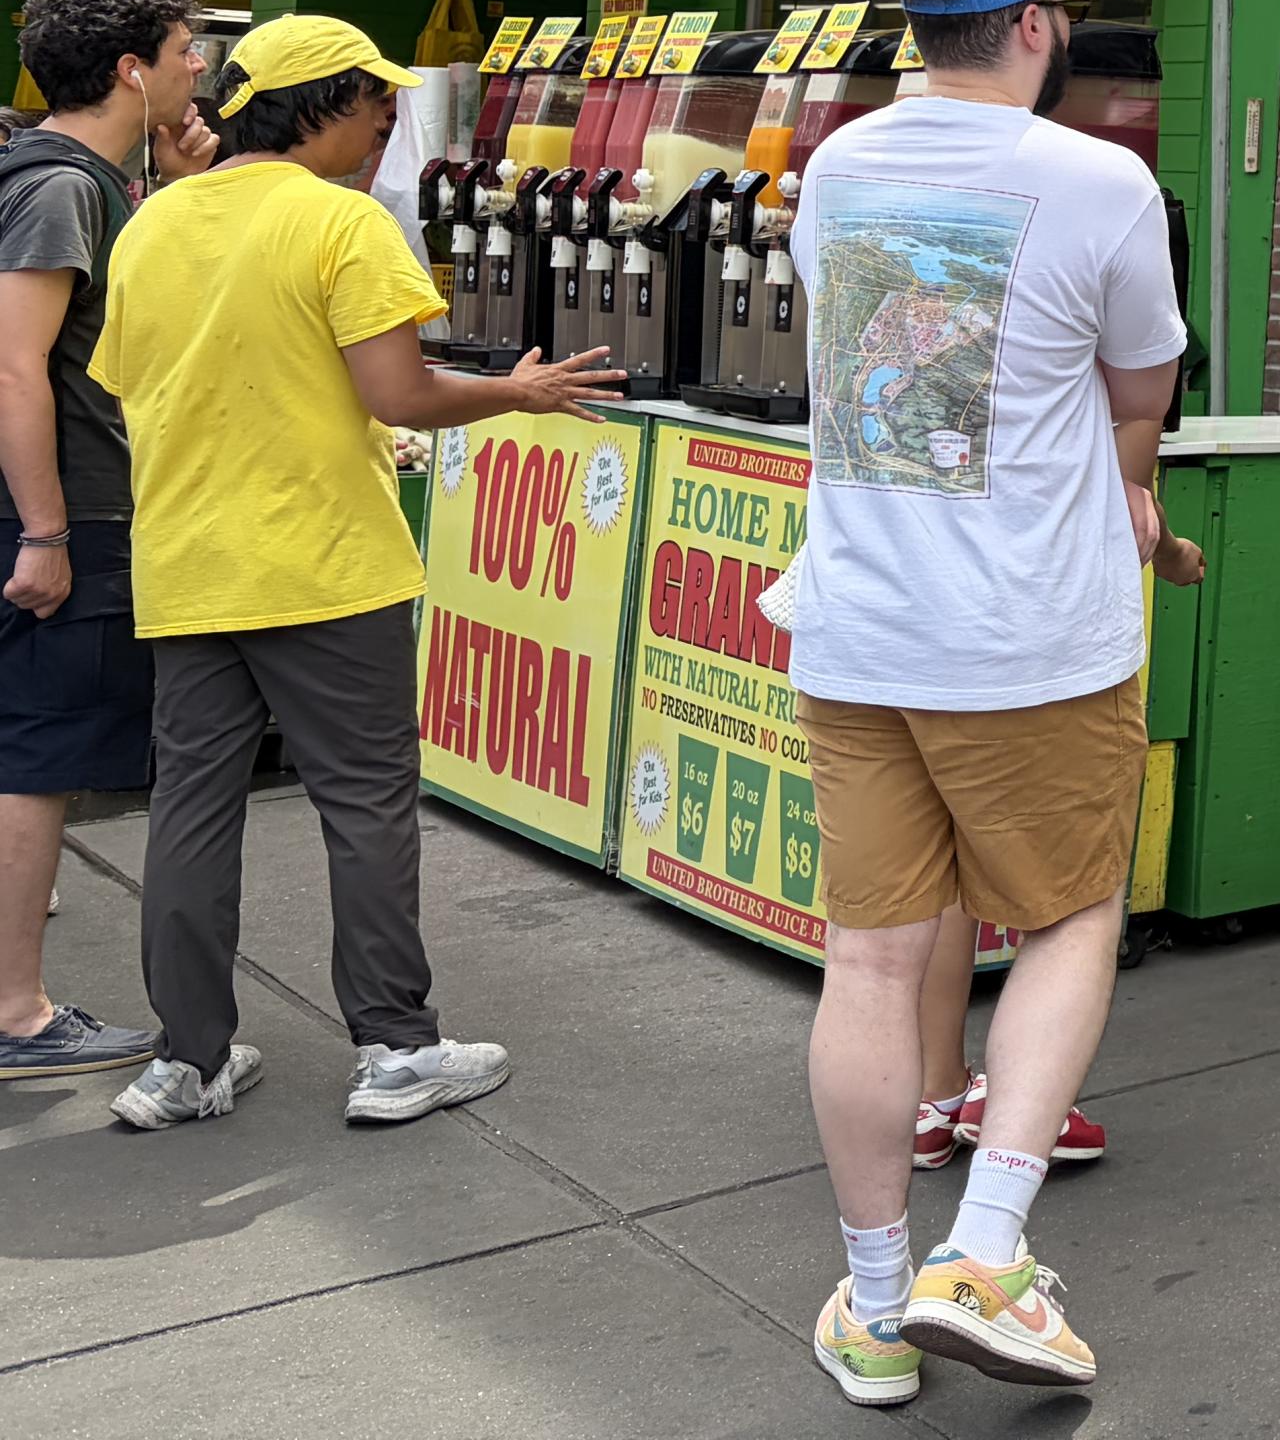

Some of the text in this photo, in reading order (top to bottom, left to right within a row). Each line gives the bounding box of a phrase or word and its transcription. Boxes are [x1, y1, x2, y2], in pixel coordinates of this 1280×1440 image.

[671, 16, 711, 33] LEMON
[596, 472, 613, 489] Best
[597, 456, 611, 469] The
[693, 443, 806, 482] UNITED BROTHERS
[469, 437, 578, 602] 100%
[590, 487, 619, 509] for Kids
[668, 477, 769, 547] HOME
[644, 644, 683, 686] WITH
[686, 658, 761, 713] NATURAL
[420, 605, 591, 807] NATURAL
[641, 686, 657, 711] NO
[660, 693, 756, 746] PRESERVATIVES
[759, 726, 778, 753] NO
[684, 761, 708, 786] 16 oz
[731, 779, 759, 805] 20 oz
[681, 792, 704, 836] $6
[729, 811, 756, 857] $7
[786, 799, 816, 826] 24 oz
[785, 832, 812, 878] $8
[652, 855, 808, 938] UNITED BROTHERS JUICE
